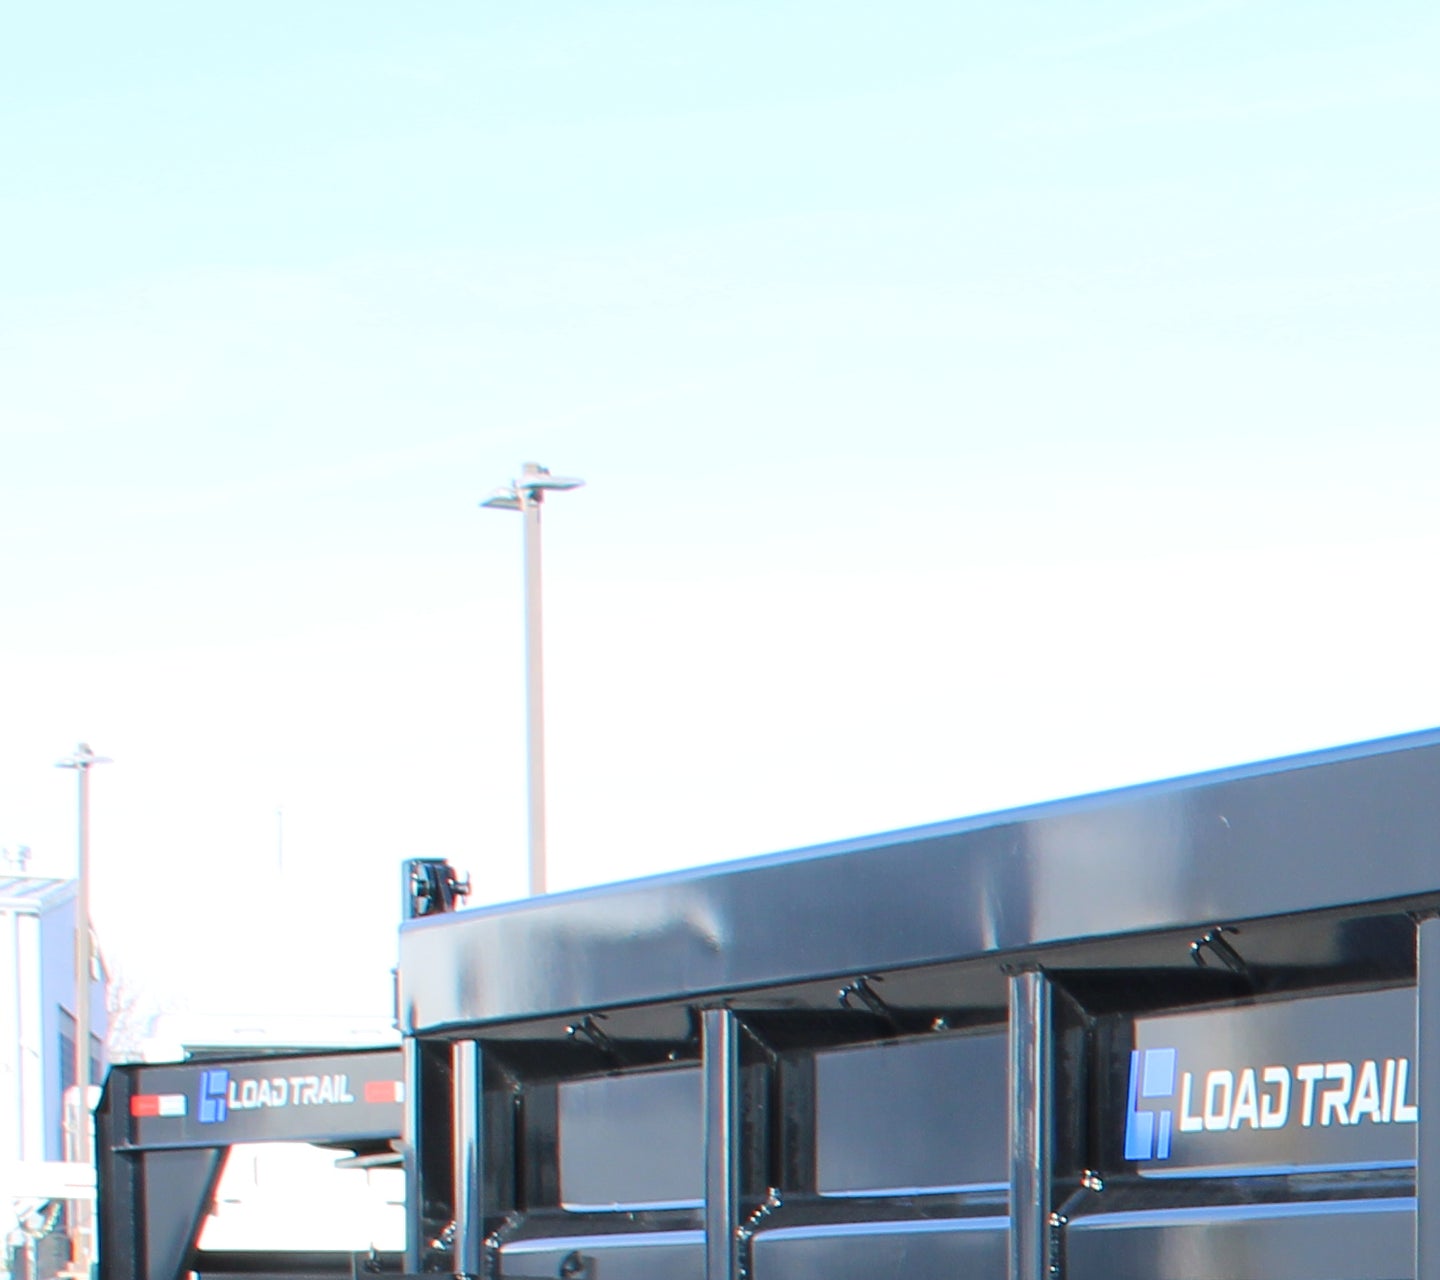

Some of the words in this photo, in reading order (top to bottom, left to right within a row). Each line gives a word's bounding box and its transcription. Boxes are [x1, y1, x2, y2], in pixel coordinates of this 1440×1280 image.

[228, 1078, 289, 1109] LOAD
[289, 1073, 354, 1105] TRAIL
[1179, 1066, 1291, 1131] LOAD
[1297, 1058, 1418, 1126] TRAIL
